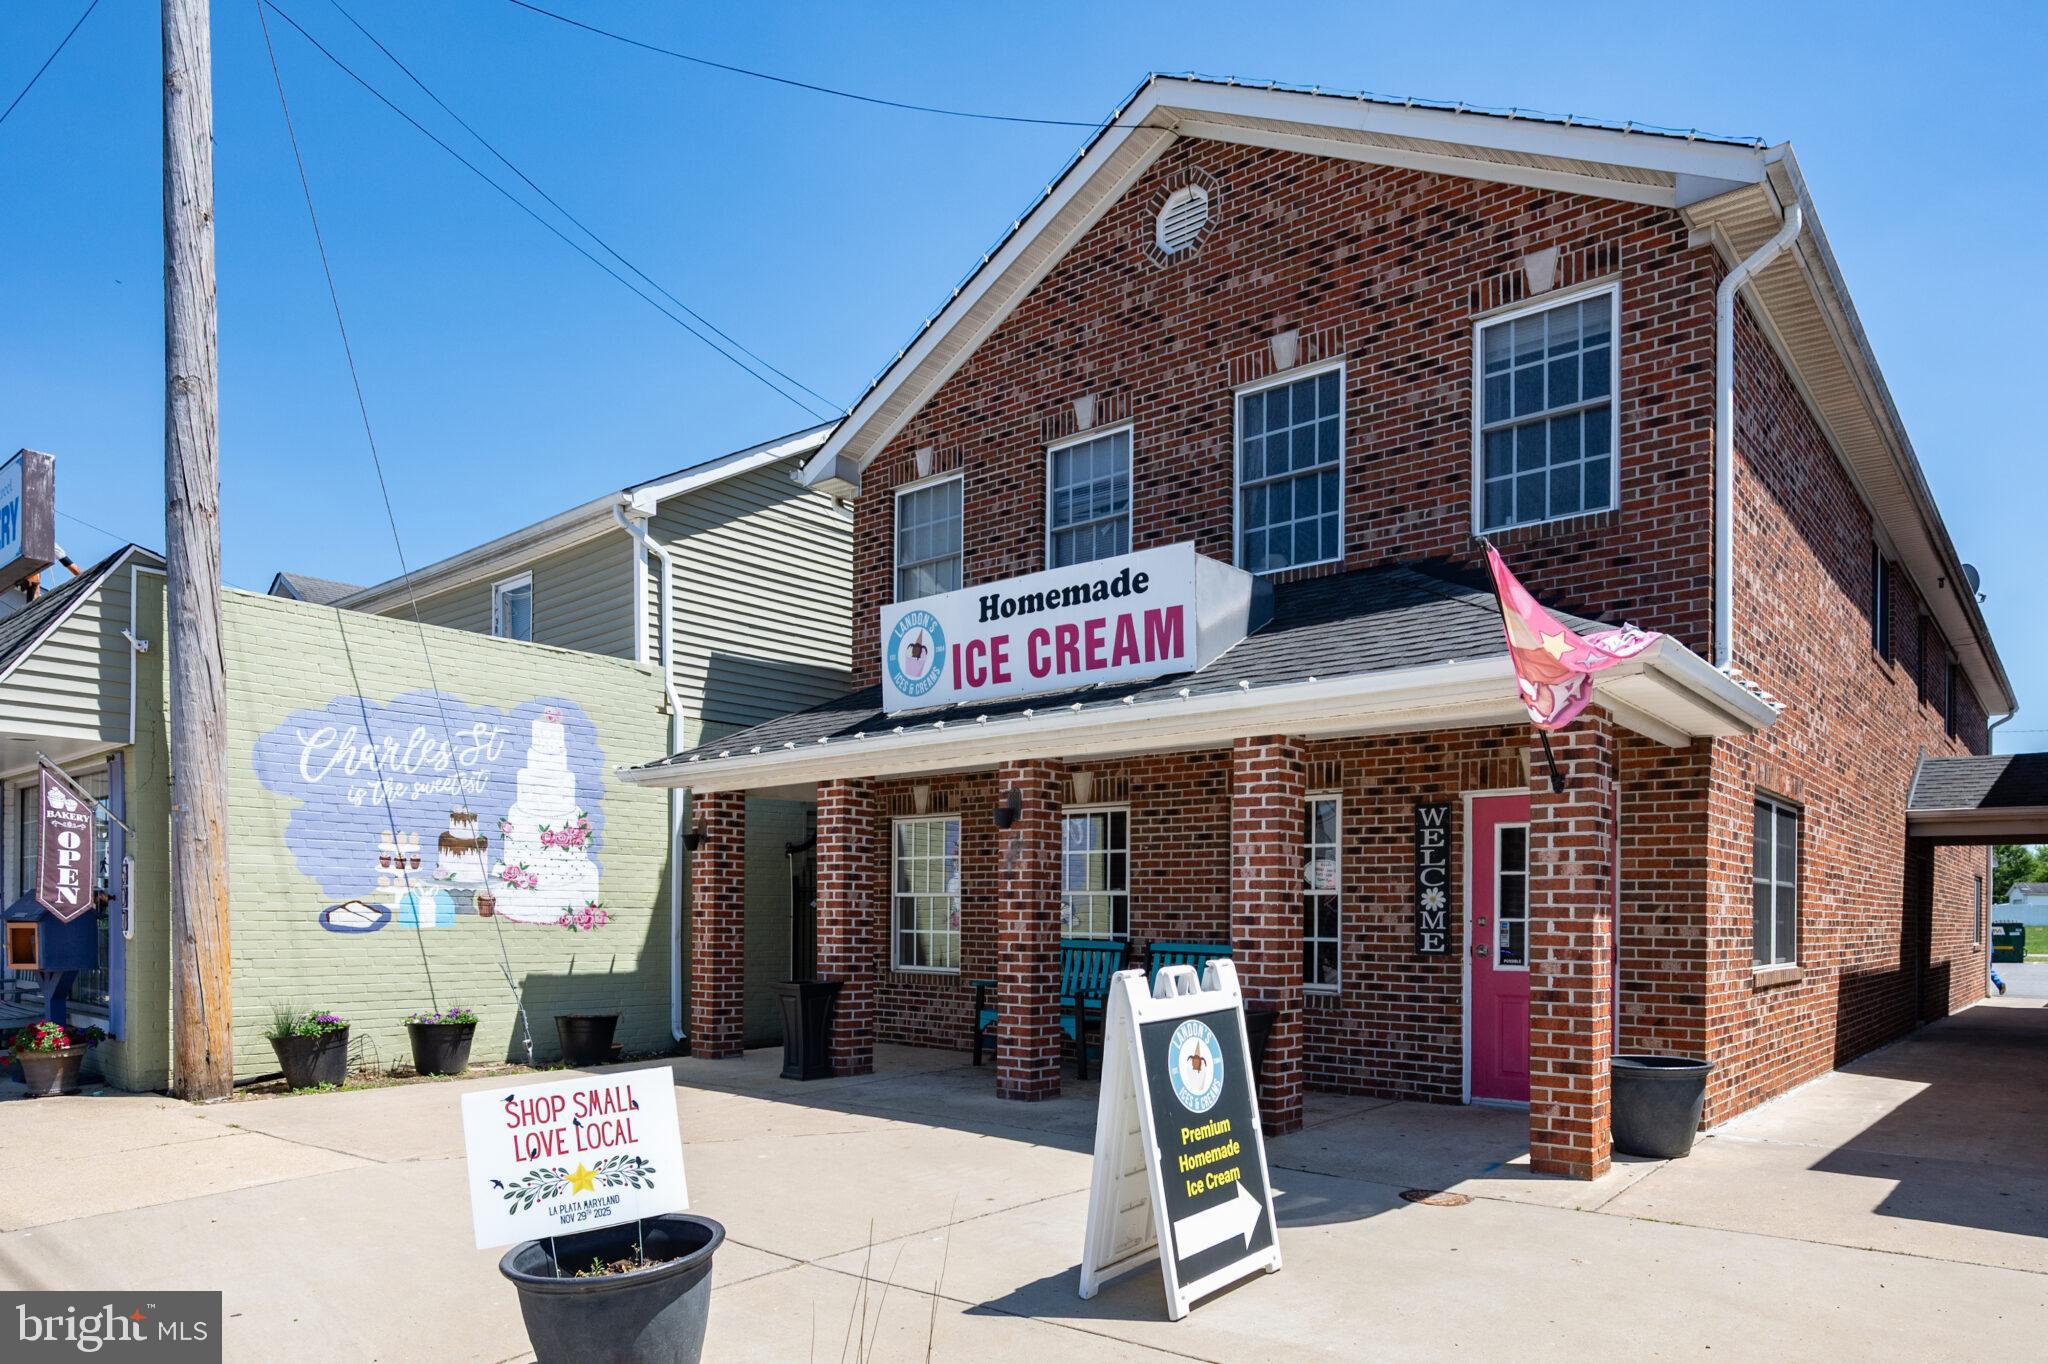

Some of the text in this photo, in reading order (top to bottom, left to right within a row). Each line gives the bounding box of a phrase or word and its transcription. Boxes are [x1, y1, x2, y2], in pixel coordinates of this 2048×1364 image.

[0, 495, 19, 550] RY
[978, 567, 1149, 623] Homemade
[895, 612, 938, 638] LANDON'S
[952, 604, 1184, 690] ICE CREAM
[894, 672, 908, 692] ICES
[915, 666, 941, 694] CREAMS
[297, 722, 510, 783] Charles St
[348, 769, 491, 806] is the sweetest
[46, 810, 90, 823] BAKERY
[55, 831, 81, 905] OPEN
[1172, 1022, 1211, 1050] LANDON'S
[505, 1085, 639, 1128] SHOP SMALL
[1179, 1086, 1194, 1107] ICES
[1201, 1078, 1220, 1109] CREAMS
[513, 1118, 639, 1162] LOVE LOCAL
[1181, 1119, 1231, 1145] Premium
[1178, 1138, 1240, 1173] Homemade
[1186, 1167, 1241, 1198] Ice Cream
[548, 1194, 620, 1216] LA PLATA MARYLAND
[560, 1213, 575, 1225] NOV
[593, 1206, 612, 1218] 2025
